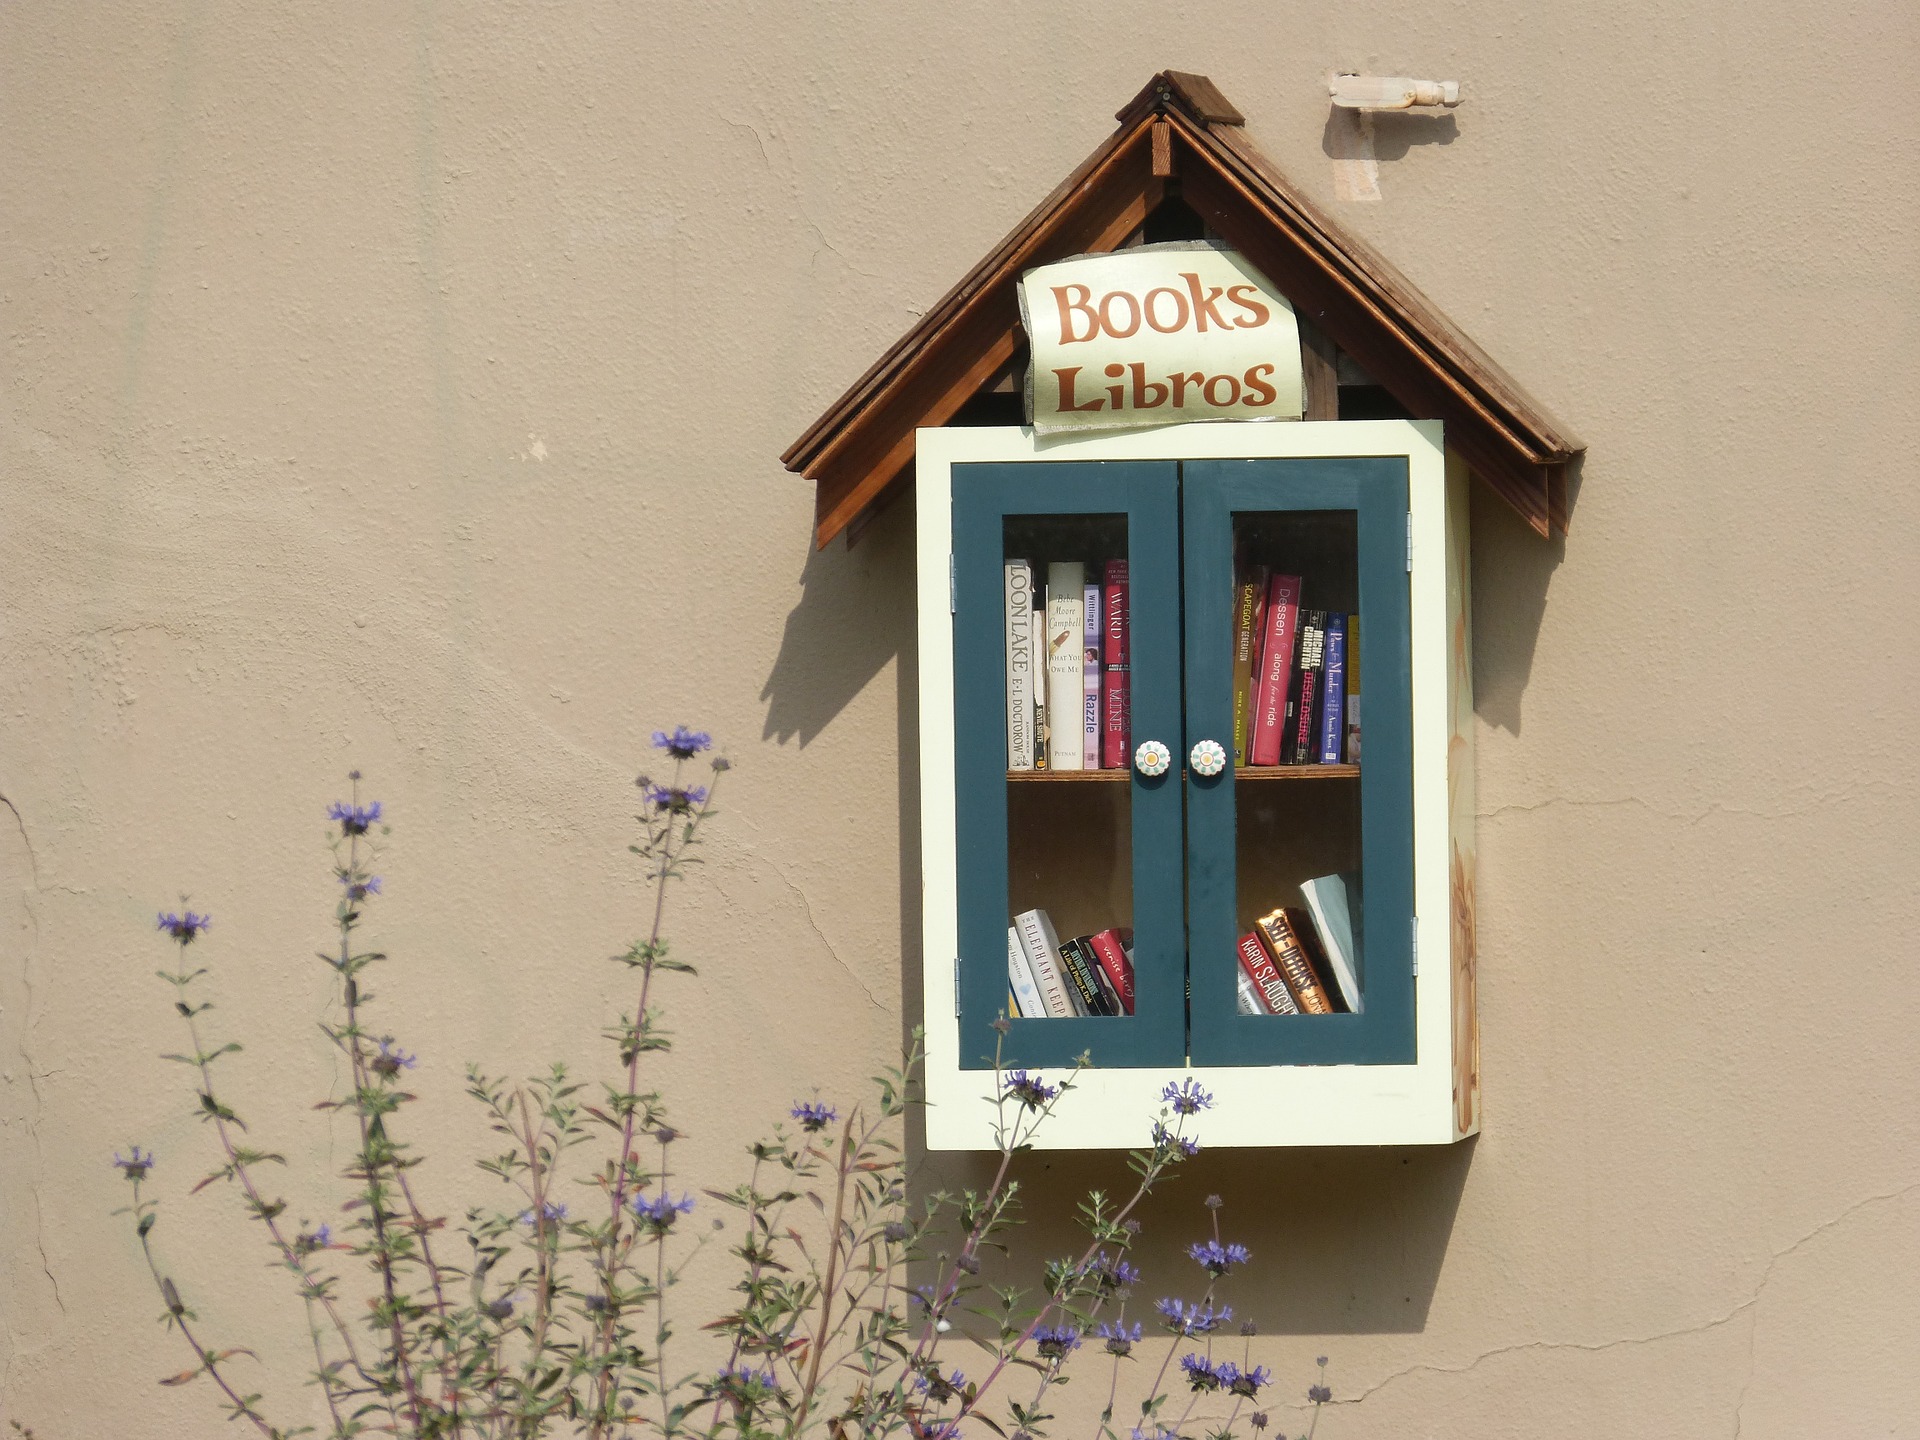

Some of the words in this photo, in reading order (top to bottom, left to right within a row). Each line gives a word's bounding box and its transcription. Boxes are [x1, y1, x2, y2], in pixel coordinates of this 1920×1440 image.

[1049, 272, 1271, 346] Books
[1051, 361, 1278, 413] Libros
[1010, 565, 1028, 618] LOON
[1055, 606, 1076, 615] Moore
[1057, 593, 1074, 603] Bebe
[1087, 594, 1096, 630] Wittlinger
[1242, 584, 1254, 632] SCAPEGOAT
[1276, 588, 1291, 636] Dessen
[1048, 617, 1081, 630] Campbell
[1110, 592, 1123, 639] WARD
[1011, 621, 1028, 672] LAKE
[1240, 631, 1250, 662] GENERATION
[1270, 653, 1283, 681] along
[1300, 626, 1314, 670] CRICHTON
[1310, 630, 1324, 668] MICHAEL
[1328, 662, 1342, 694] Murder
[1012, 699, 1023, 753] DOCTOROW
[1085, 694, 1097, 733] Razzle
[1110, 688, 1122, 732] MINE
[1267, 706, 1277, 726] ride
[1298, 672, 1314, 744] DISCLOSURE
[1024, 923, 1054, 982] ELEPHANT
[1047, 986, 1068, 1018] KEEP
[1103, 946, 1121, 973] venise
[1119, 973, 1135, 998] berry
[1240, 938, 1266, 969] KARIN
[1265, 916, 1318, 994] SELF-DEFENSE
